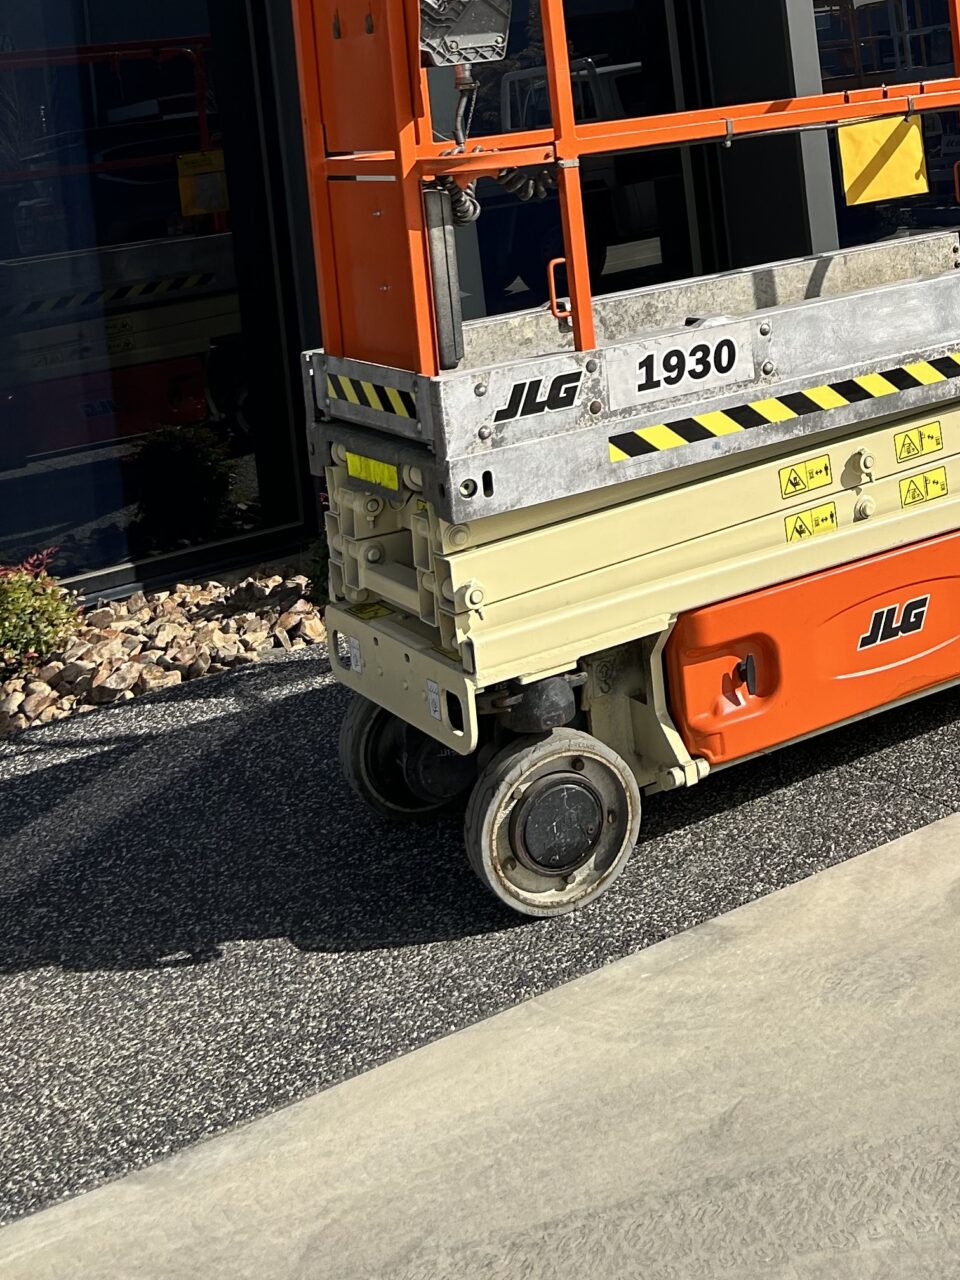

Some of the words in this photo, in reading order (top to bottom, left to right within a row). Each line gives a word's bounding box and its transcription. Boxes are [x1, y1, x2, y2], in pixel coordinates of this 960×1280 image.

[493, 370, 583, 423] JLG
[637, 338, 737, 393] 1930
[857, 594, 930, 651] JLG
